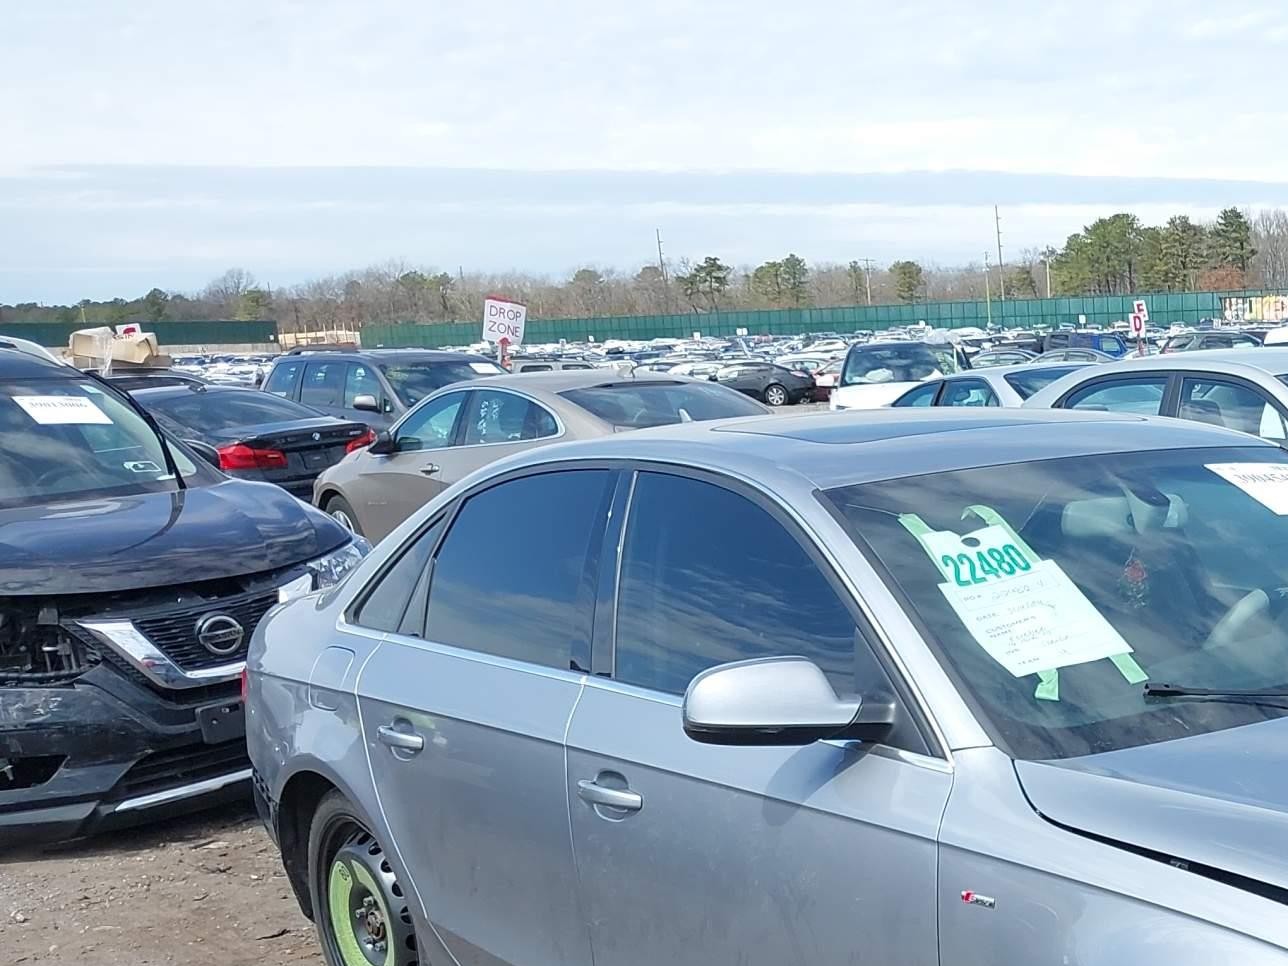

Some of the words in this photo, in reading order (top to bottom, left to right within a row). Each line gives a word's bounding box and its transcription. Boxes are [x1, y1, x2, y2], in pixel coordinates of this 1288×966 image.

[489, 304, 521, 321] DROP
[488, 320, 521, 338] ZONE
[1133, 315, 1142, 331] D
[941, 544, 1031, 586] 22480
